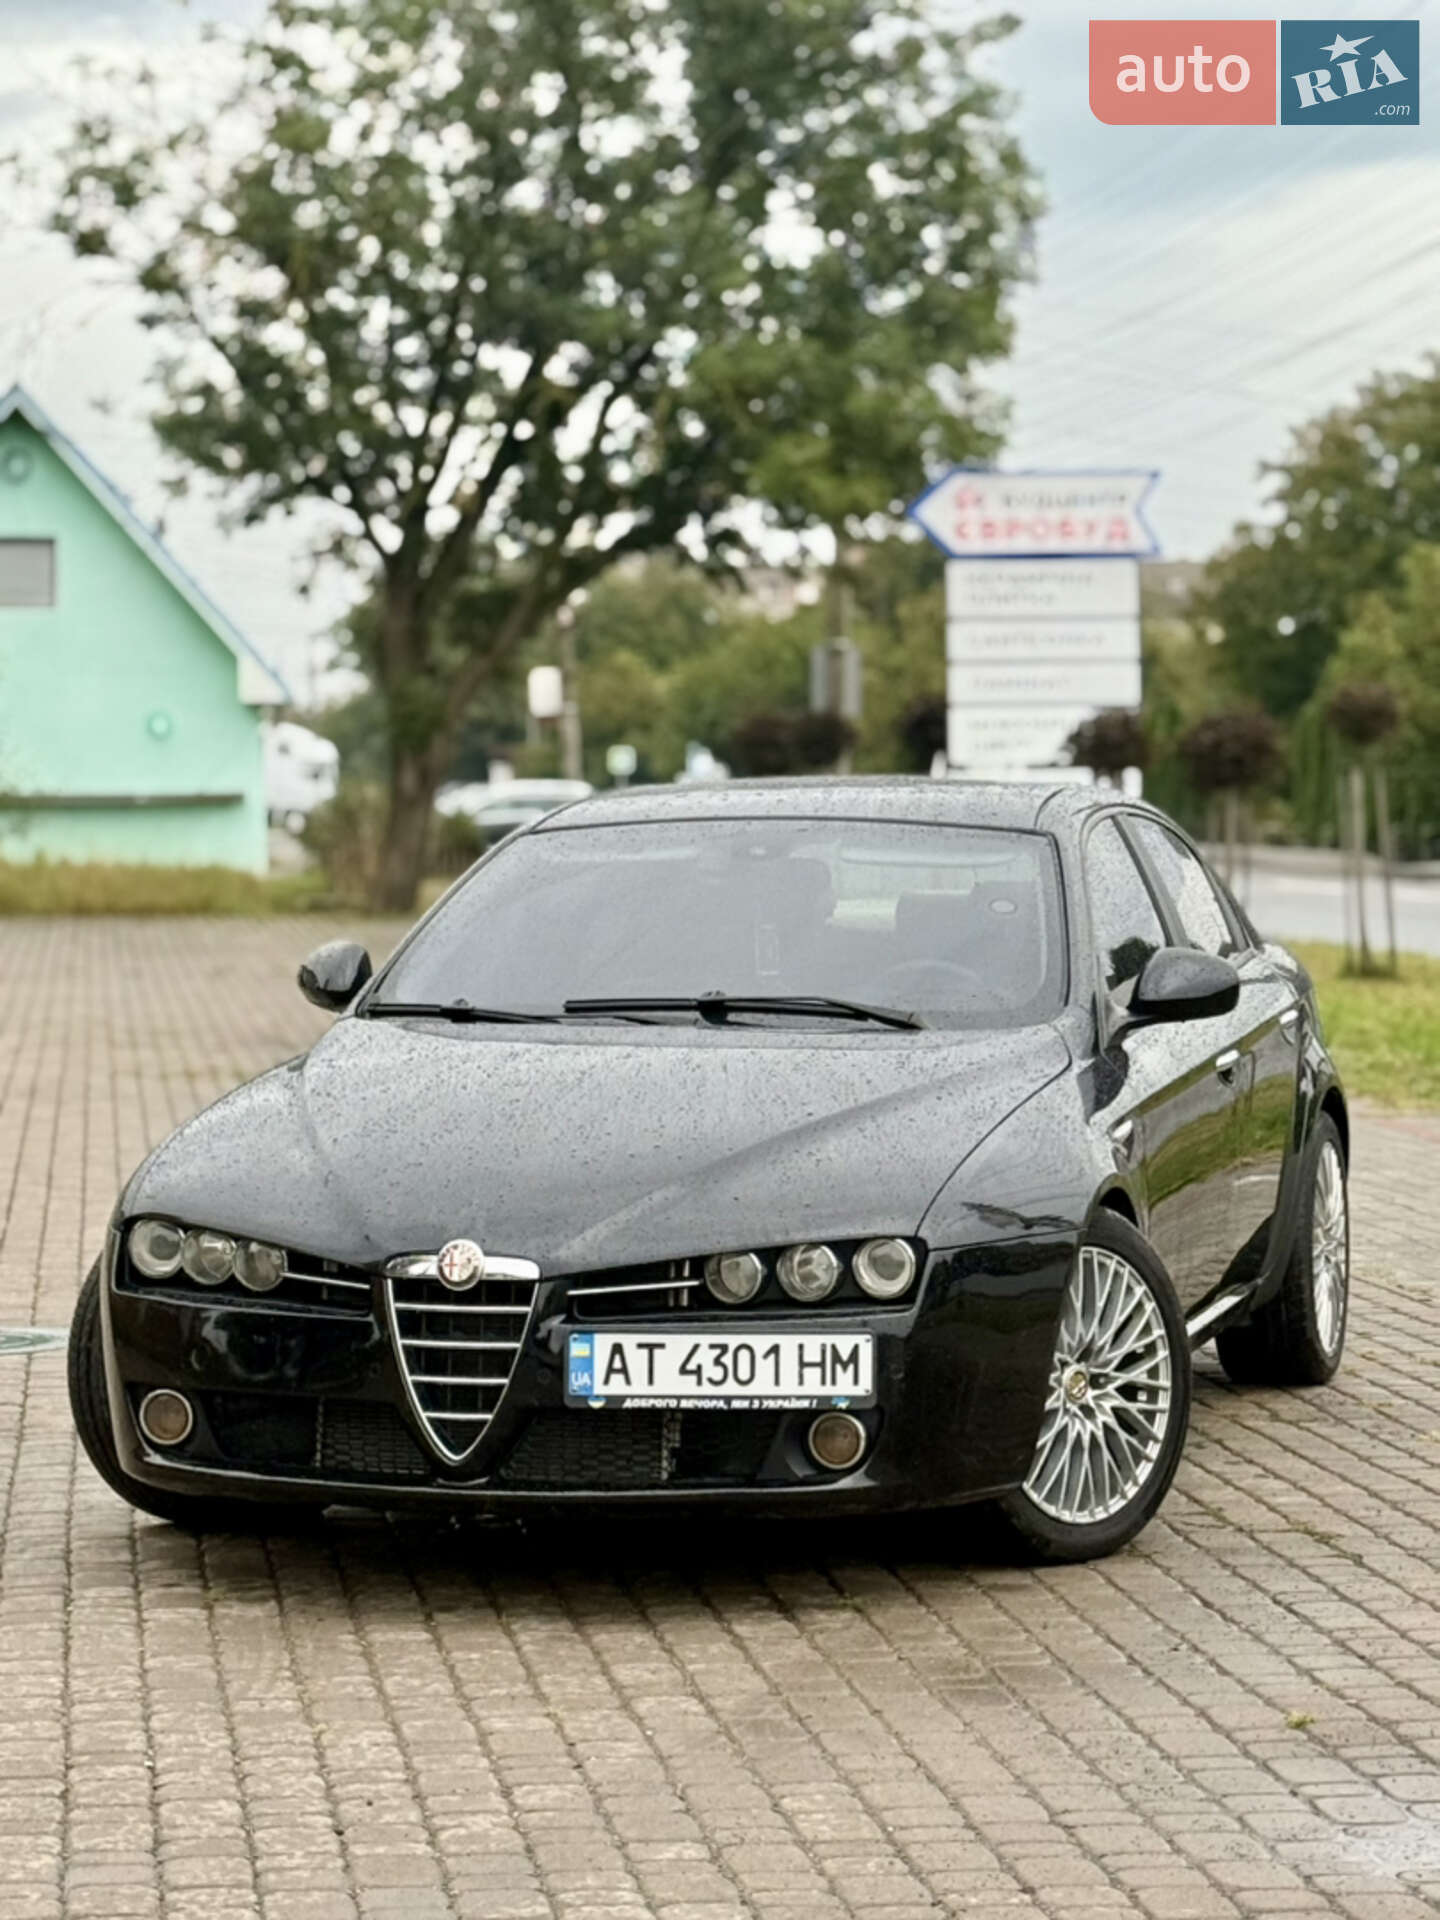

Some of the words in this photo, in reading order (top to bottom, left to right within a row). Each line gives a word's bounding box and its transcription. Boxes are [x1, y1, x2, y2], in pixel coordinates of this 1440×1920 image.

[572, 1372, 591, 1386] UA
[603, 1342, 666, 1386] AT
[679, 1343, 780, 1387] 4301
[798, 1343, 859, 1386] HM
